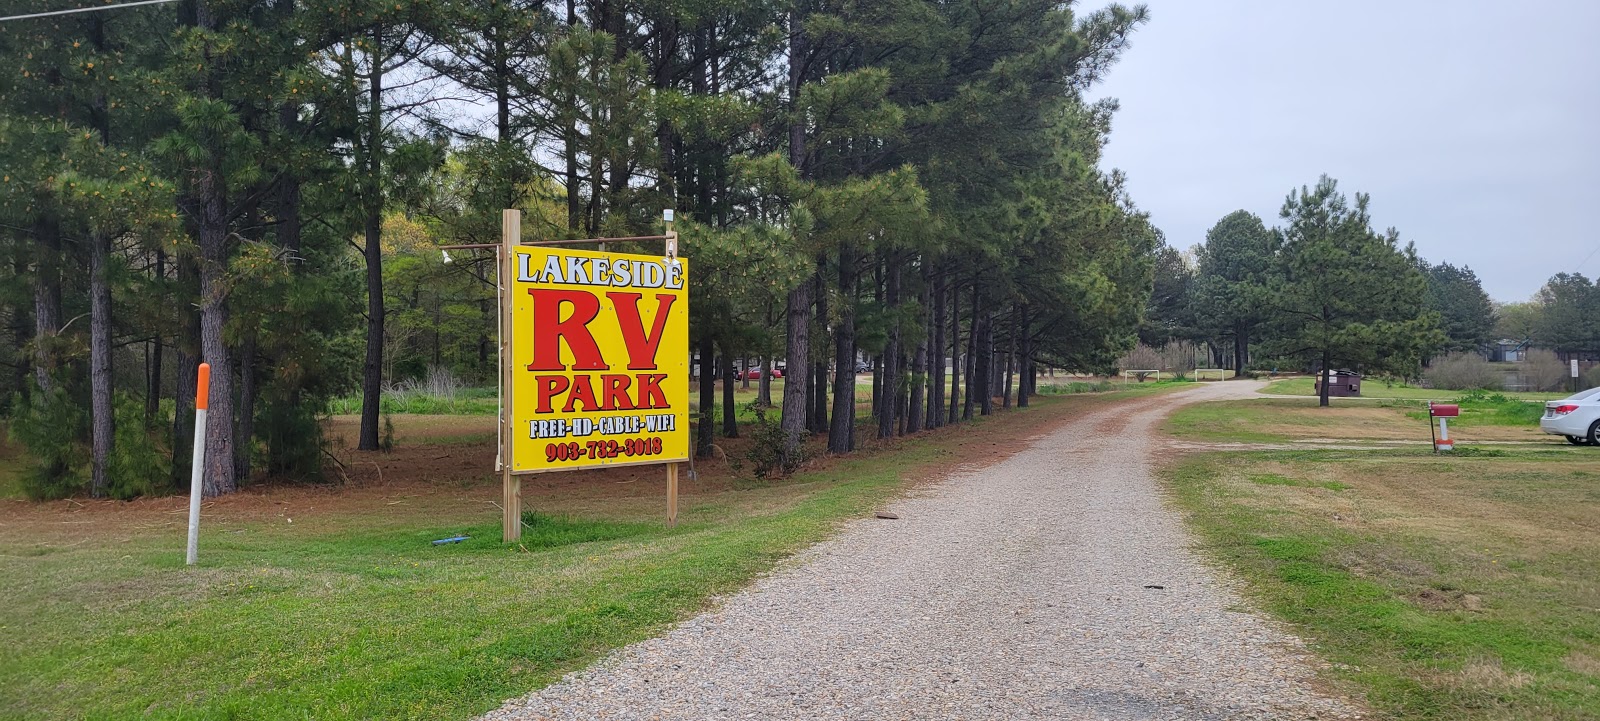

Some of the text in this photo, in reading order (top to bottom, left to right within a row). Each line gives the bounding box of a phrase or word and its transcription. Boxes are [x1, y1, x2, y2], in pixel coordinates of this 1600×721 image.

[517, 253, 684, 289] LAKESIDE
[527, 288, 676, 371] RV
[535, 373, 671, 413] PARK
[545, 437, 662, 461] 903-732-3018
